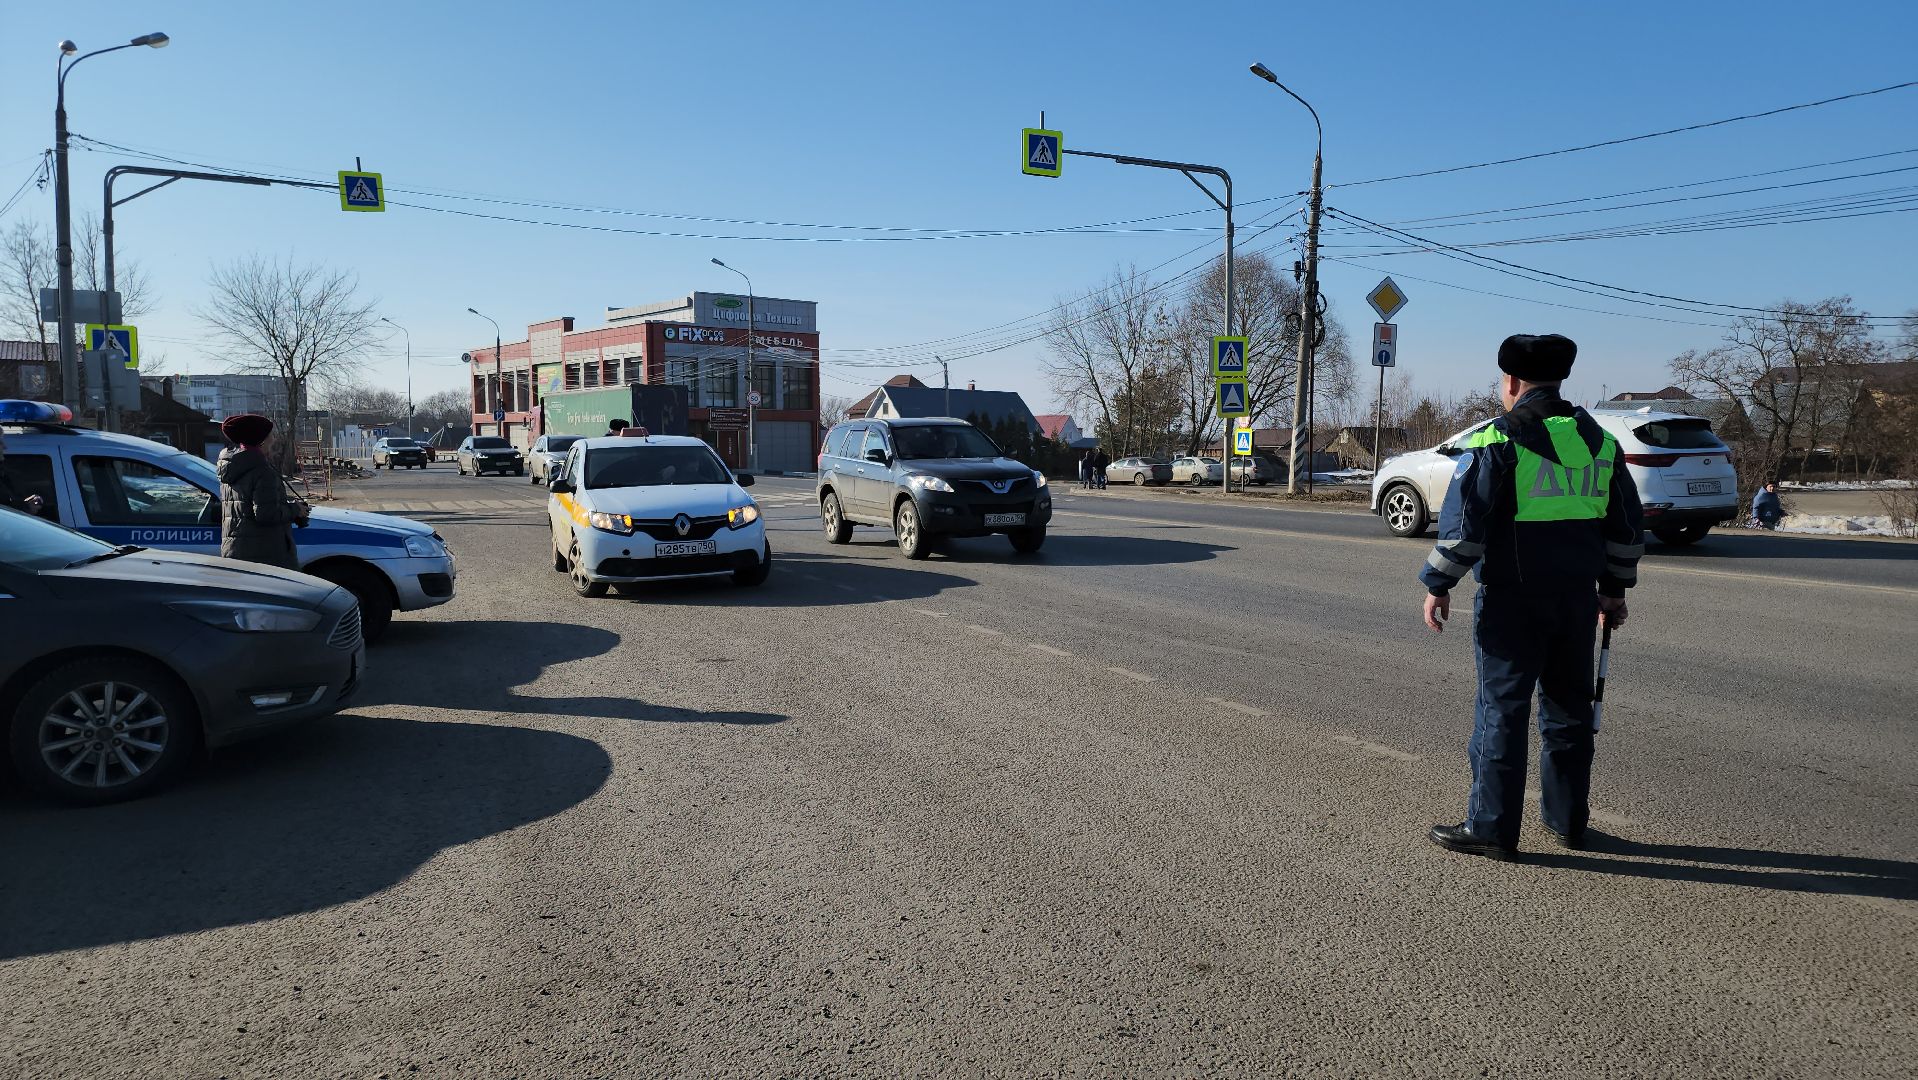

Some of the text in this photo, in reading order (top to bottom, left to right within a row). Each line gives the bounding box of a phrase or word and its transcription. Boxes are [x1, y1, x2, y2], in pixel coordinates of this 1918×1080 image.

[765, 312, 802, 325] Техника
[755, 336, 803, 347] МЕБЕЛЬ
[1527, 457, 1612, 498] ДПС
[131, 530, 214, 542] ПОЛИЦИЯ
